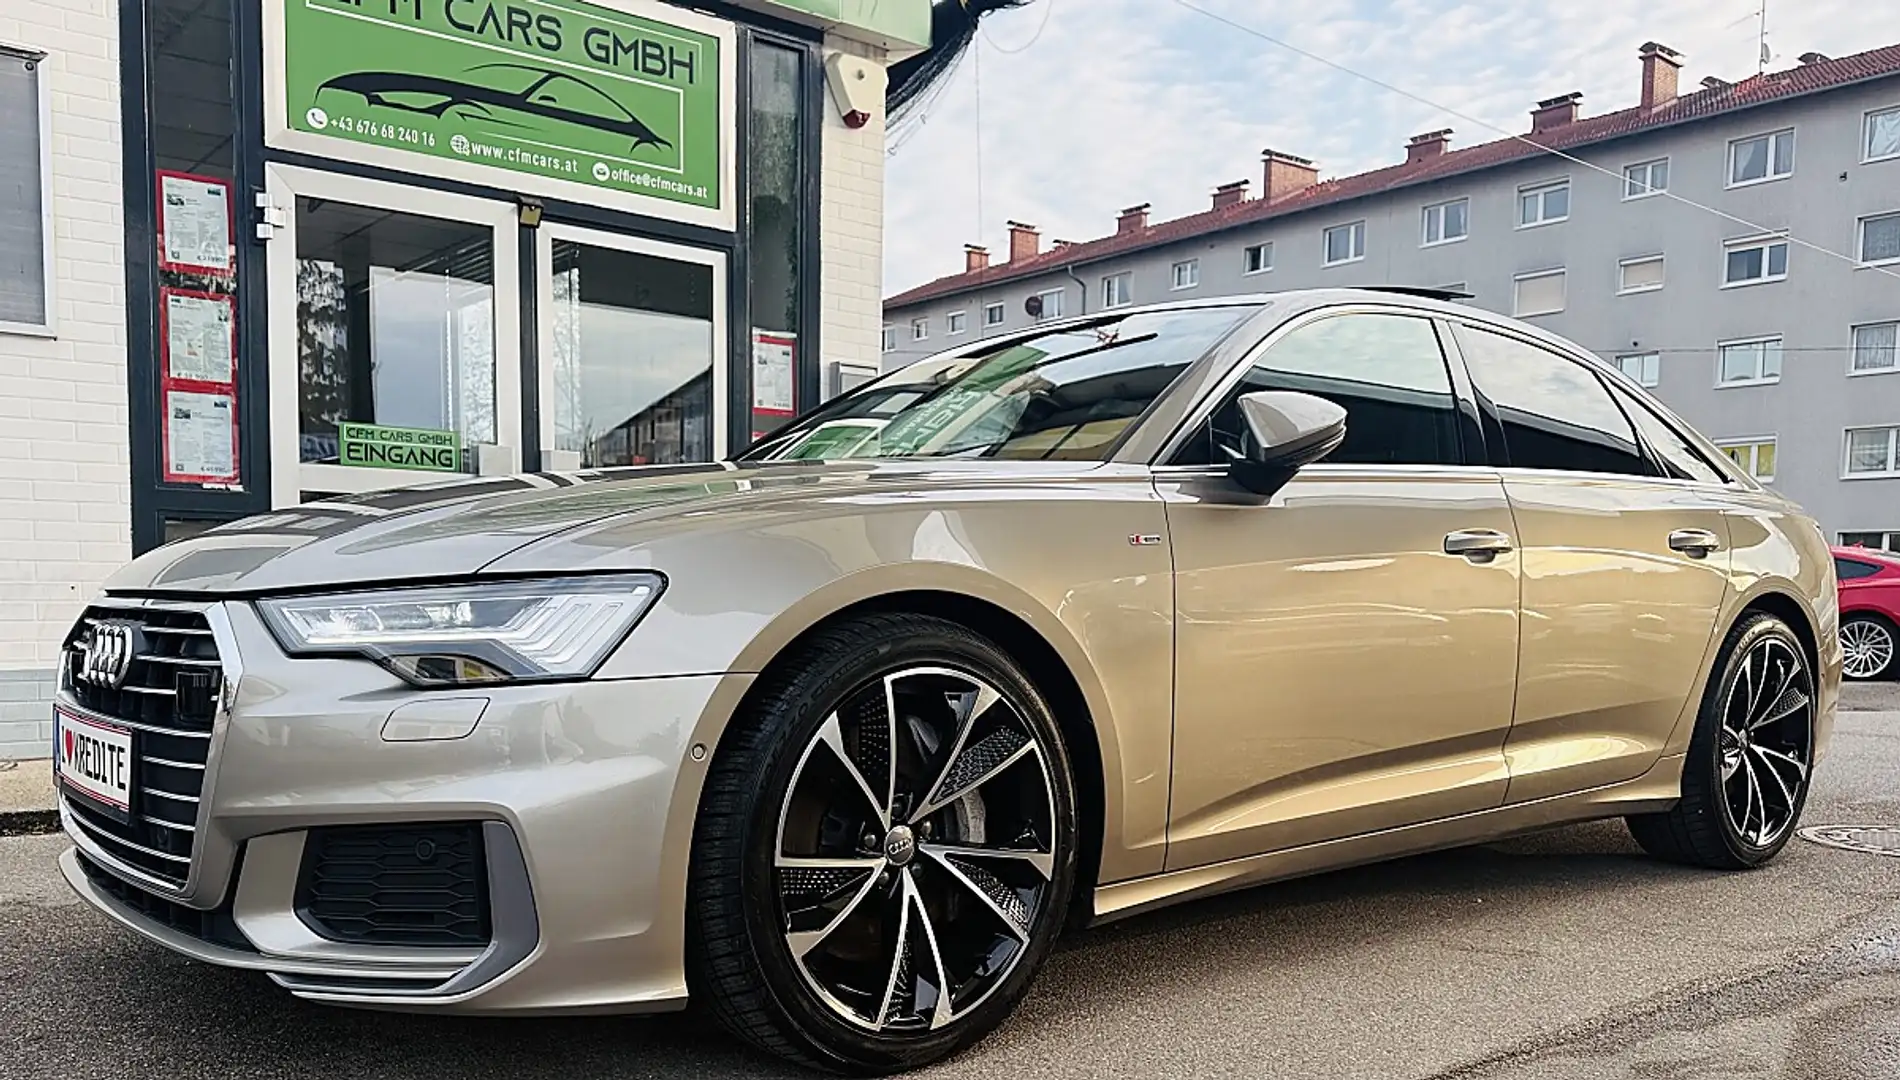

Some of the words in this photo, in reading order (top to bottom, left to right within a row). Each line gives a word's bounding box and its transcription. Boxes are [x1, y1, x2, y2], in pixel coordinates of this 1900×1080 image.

[444, 0, 562, 52] CARS
[583, 27, 695, 84] GMBH
[330, 116, 353, 131] +43
[356, 119, 377, 136] 676
[381, 123, 394, 139] 68
[398, 127, 418, 144] 240
[421, 131, 436, 147] 16
[471, 142, 578, 173] www.cfmcars.at
[611, 168, 708, 198] office@cfmcars.at
[346, 427, 375, 439] CFM
[380, 431, 413, 442] CARS
[418, 433, 453, 446] GMBH
[346, 442, 453, 467] EINGANG
[74, 732, 127, 791] KREDITE
